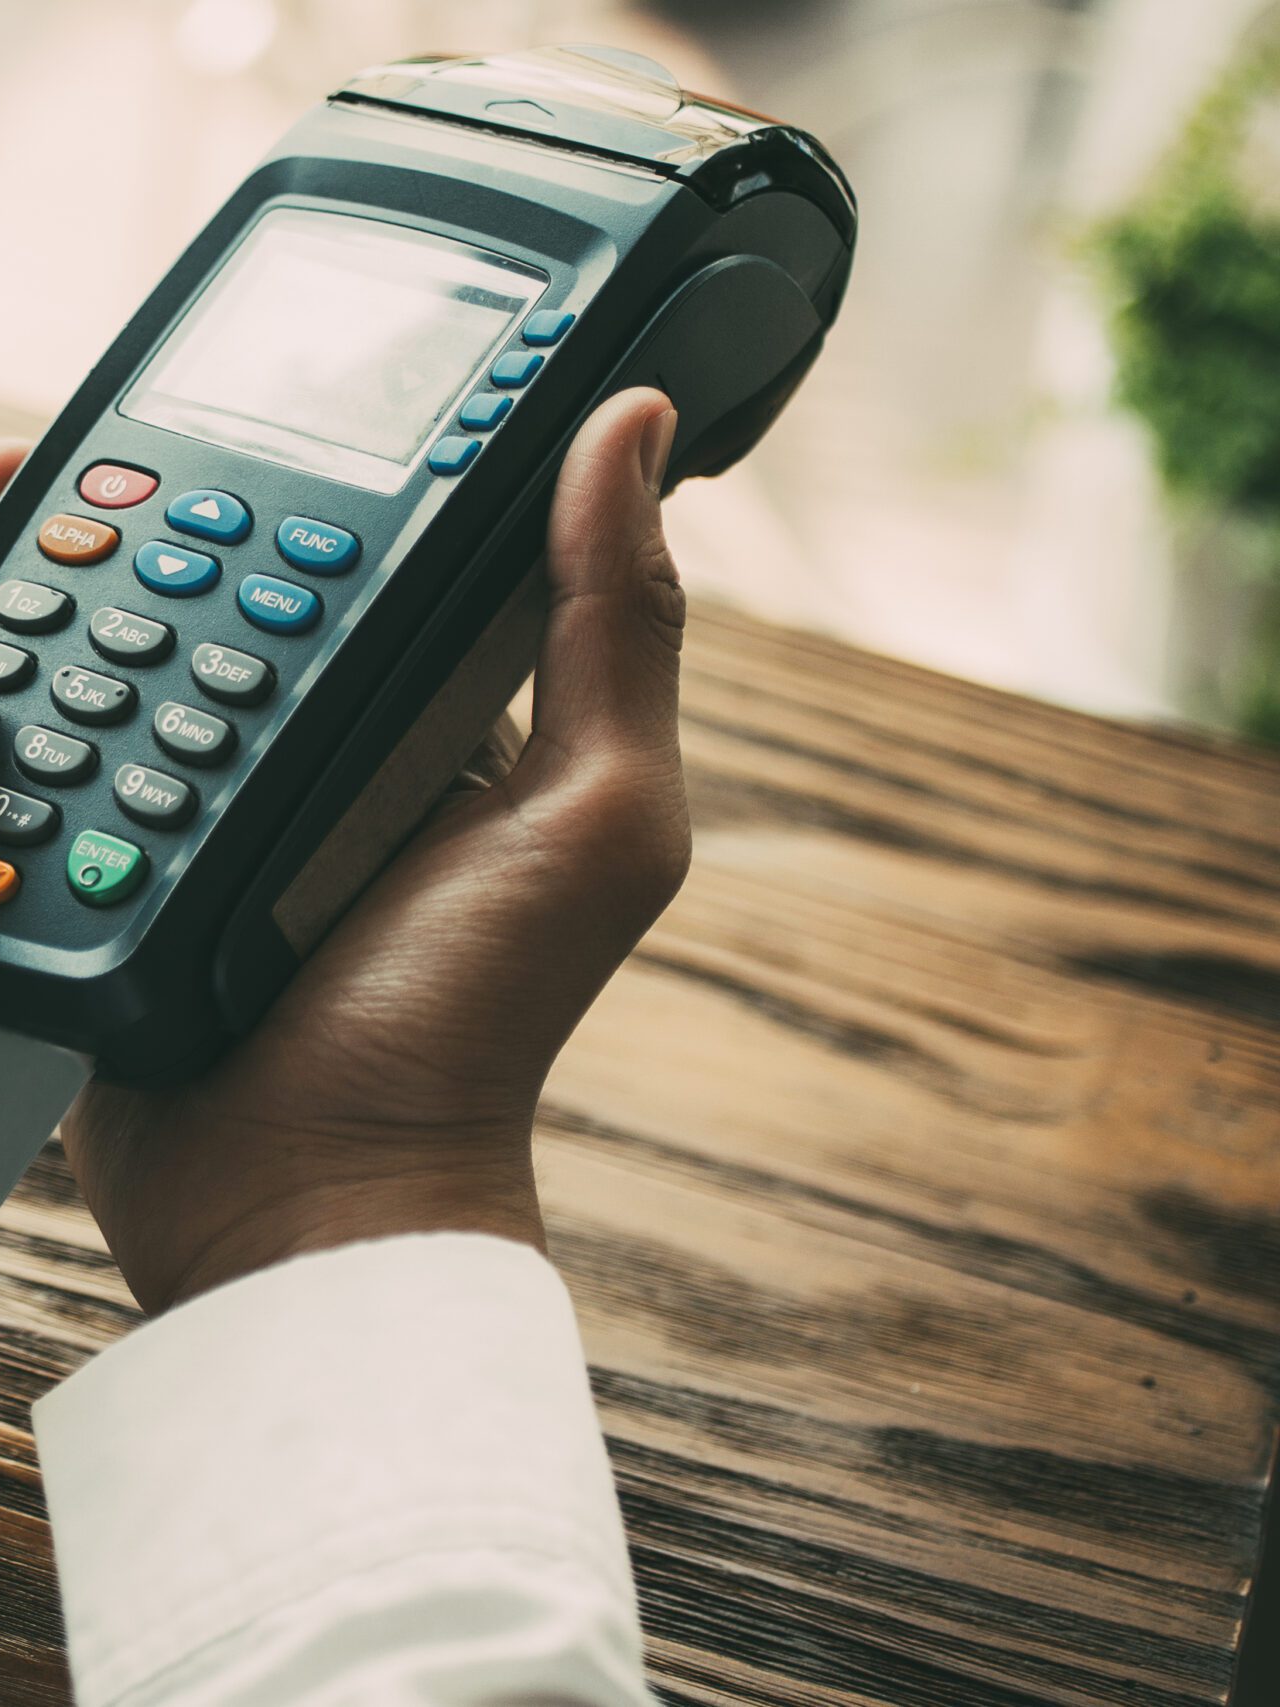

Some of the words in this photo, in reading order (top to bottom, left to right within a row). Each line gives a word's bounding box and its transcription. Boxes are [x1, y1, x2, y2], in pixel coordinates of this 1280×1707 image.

[45, 522, 97, 549] ALPHA
[289, 528, 338, 553] FUNC
[250, 587, 302, 614] MENU
[75, 840, 132, 871] ENTER
